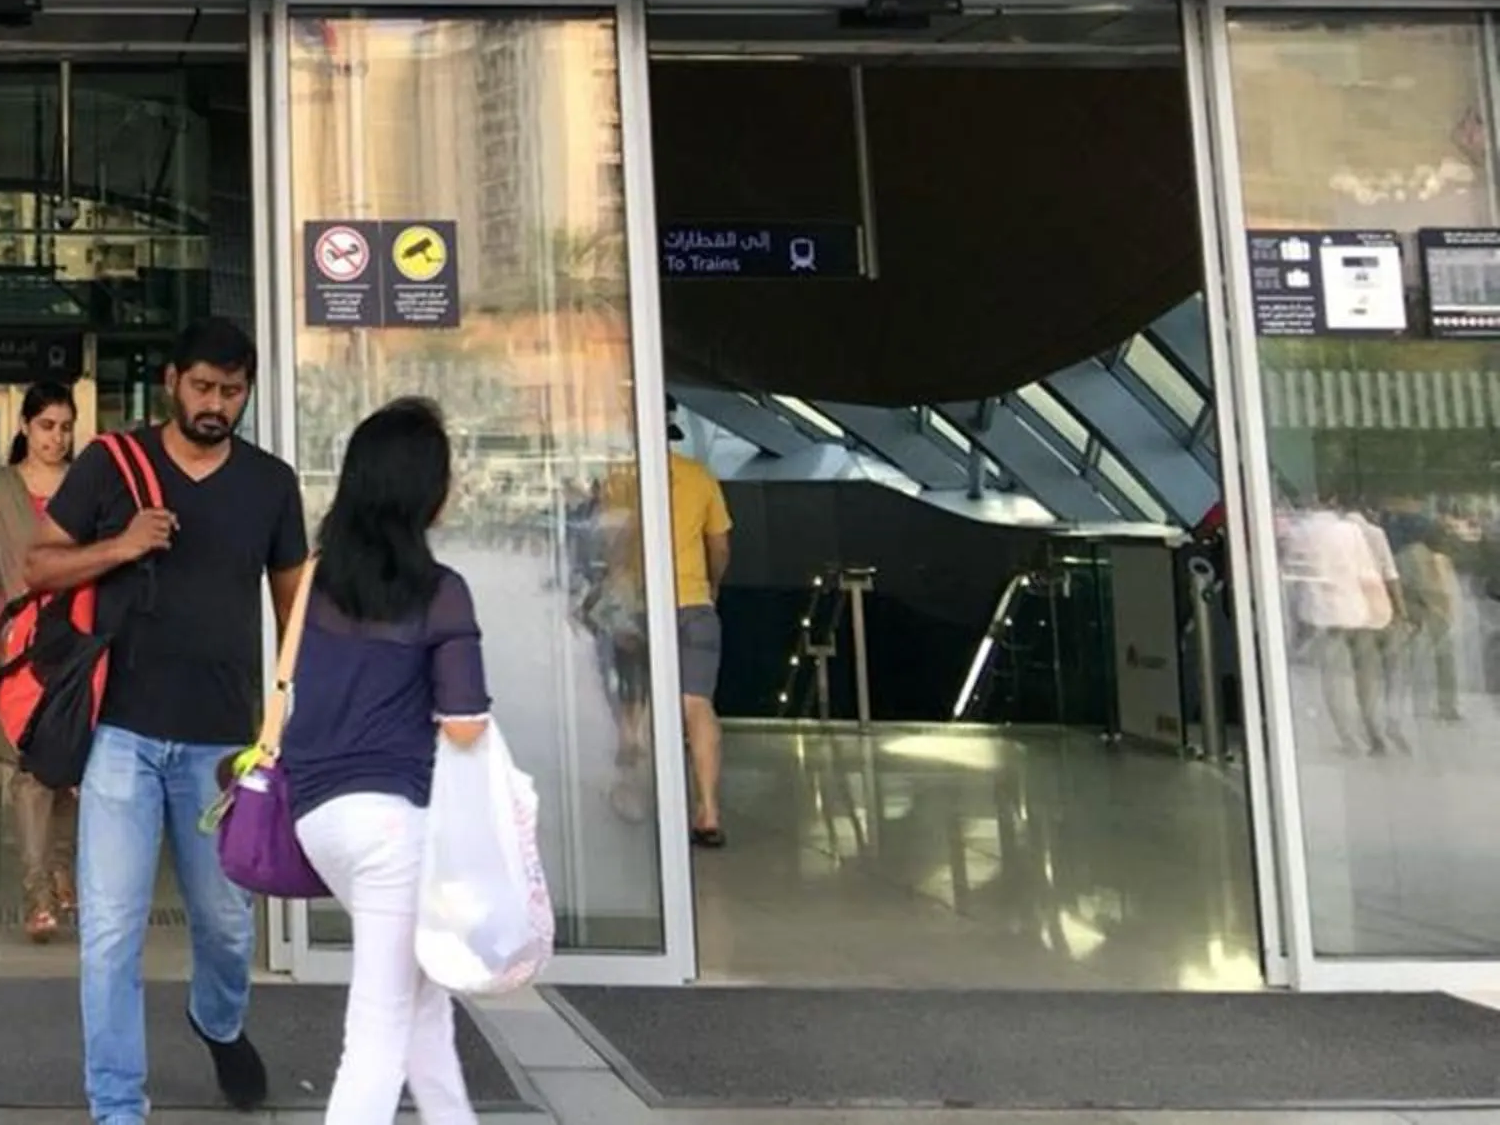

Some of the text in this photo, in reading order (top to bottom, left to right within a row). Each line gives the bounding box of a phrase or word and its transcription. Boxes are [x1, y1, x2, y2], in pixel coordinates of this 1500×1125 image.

[663, 229, 771, 252] إلى القطارات
[665, 255, 741, 272] To Trains
